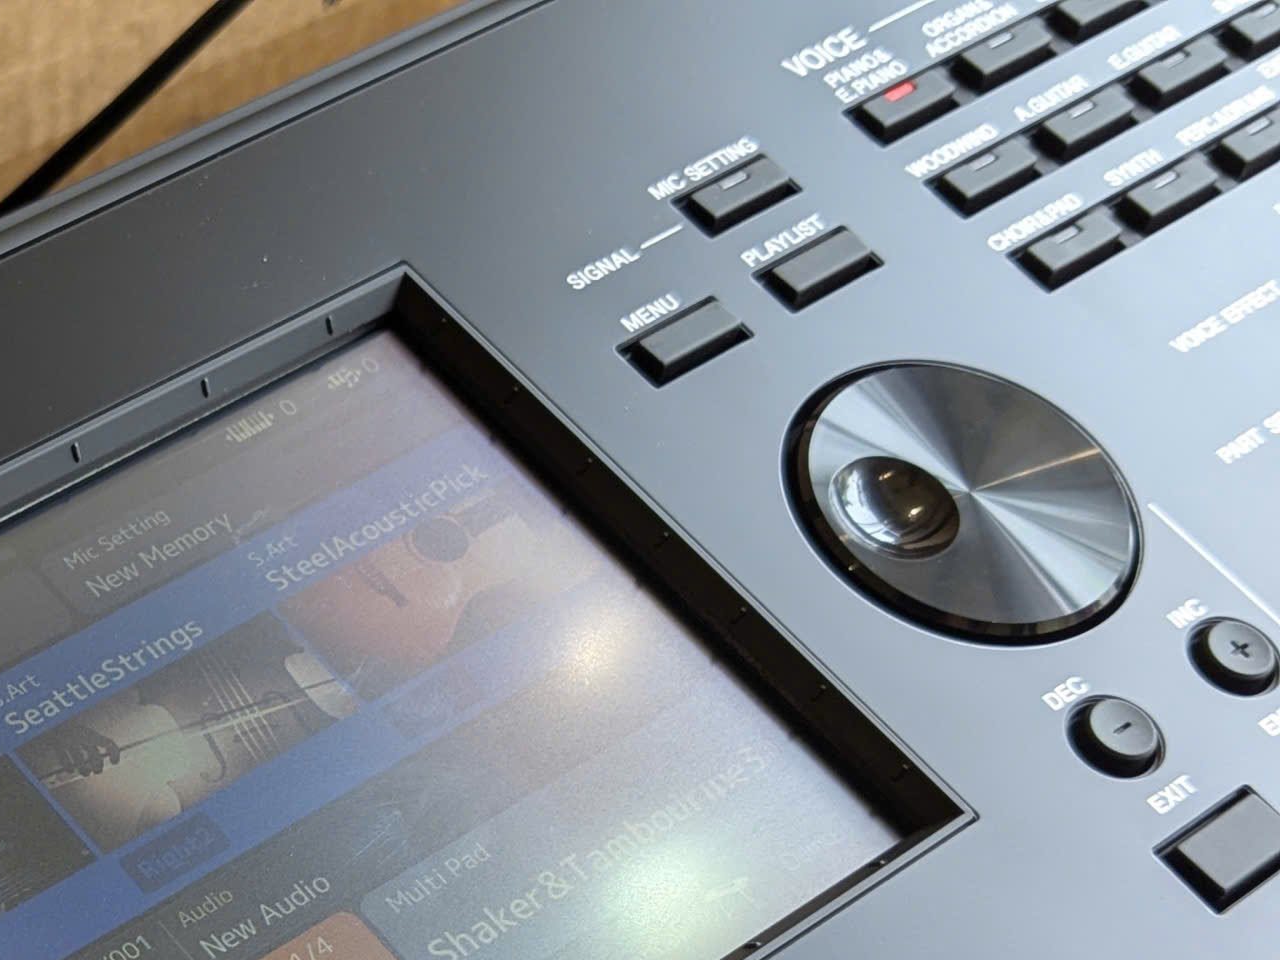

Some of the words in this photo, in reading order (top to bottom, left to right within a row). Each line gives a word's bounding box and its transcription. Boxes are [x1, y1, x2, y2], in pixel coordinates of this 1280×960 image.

[781, 24, 867, 77] VOICE
[924, 3, 1018, 58] ACCORDION
[834, 60, 909, 104] E.PIANO
[647, 174, 686, 200] MIC
[683, 136, 759, 182] SETTING
[904, 123, 999, 178] WOODWIND
[1103, 148, 1163, 188] SYNTH
[740, 213, 826, 268] PLAYLIST
[566, 247, 640, 290] SIGNAL
[620, 294, 681, 332] MENU
[1168, 315, 1228, 352] VOICE
[1215, 427, 1266, 464] PART
[63, 547, 98, 571] Mic
[98, 510, 172, 552] Setting
[247, 533, 299, 568] S.Art
[264, 462, 489, 591] SteelAcousticPick
[84, 563, 139, 599] New
[139, 512, 233, 564] Memory
[1166, 598, 1208, 629] INC
[4, 617, 204, 734] SeattleStrings
[1041, 676, 1090, 711] DEC
[1146, 775, 1199, 815] EXIT
[385, 873, 447, 914] Multi
[448, 842, 492, 877] Pad
[177, 888, 234, 930] Audio
[200, 923, 256, 960] New
[257, 875, 331, 938] Audio
